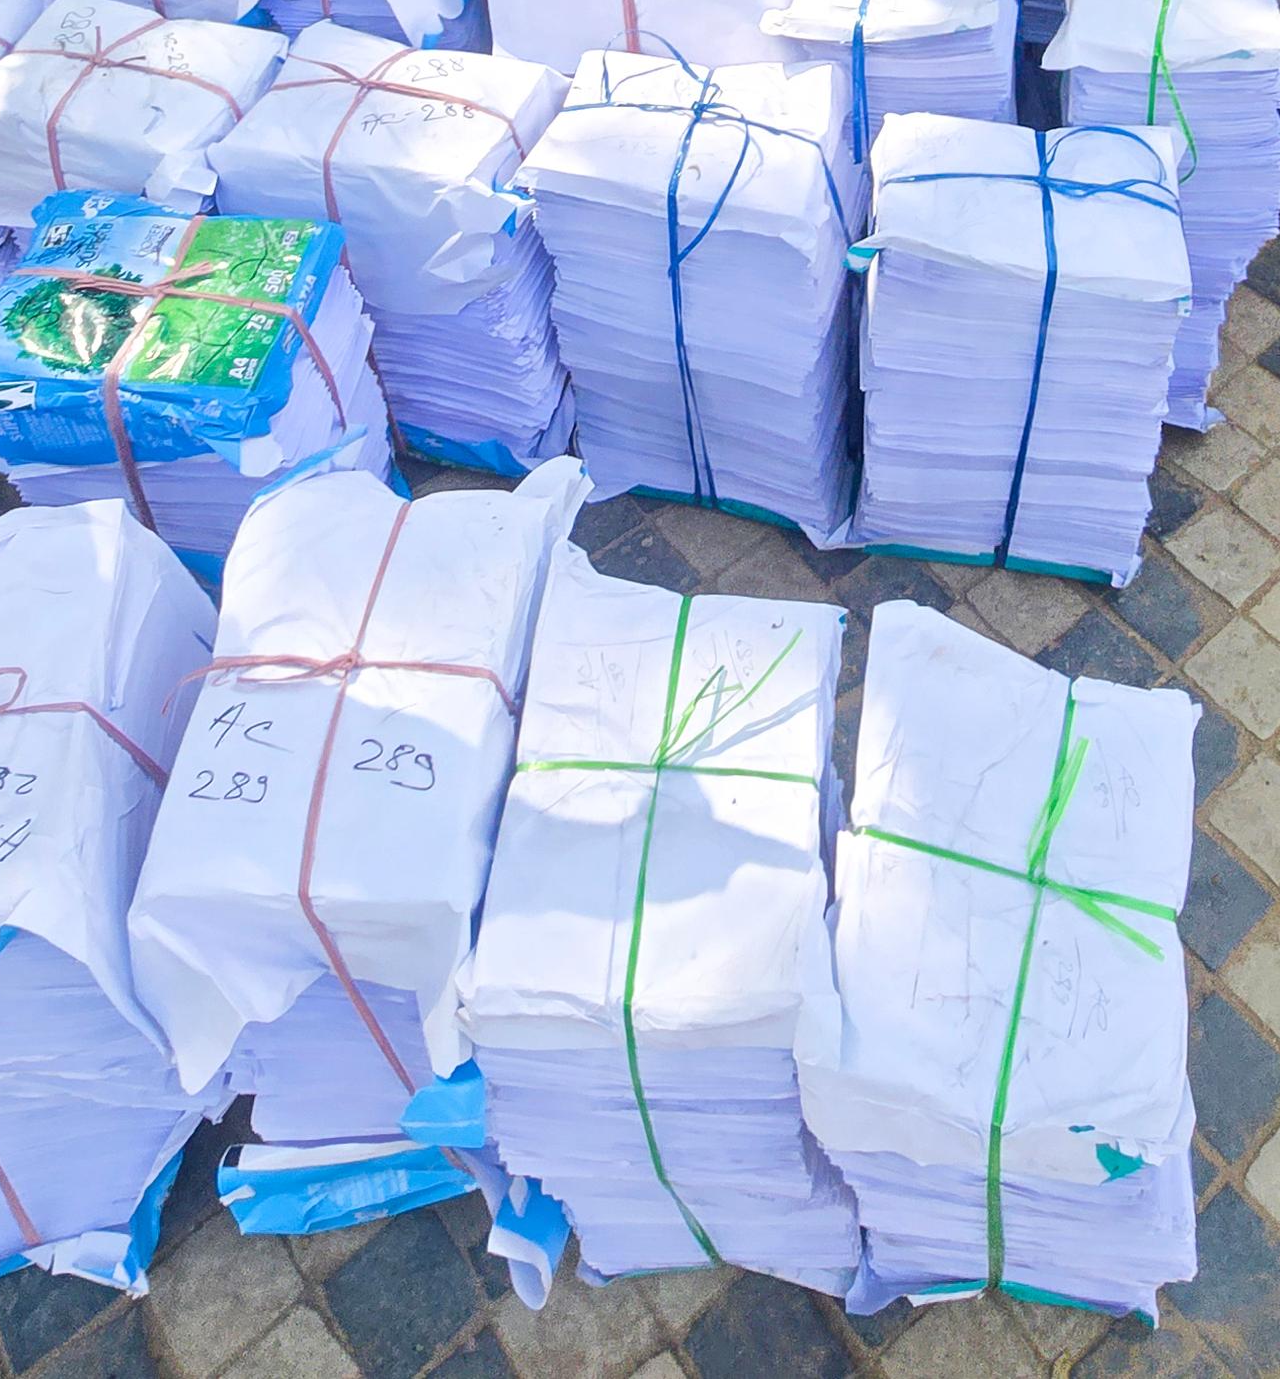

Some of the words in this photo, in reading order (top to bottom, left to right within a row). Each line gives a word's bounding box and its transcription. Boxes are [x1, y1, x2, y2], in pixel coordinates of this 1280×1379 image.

[246, 313, 267, 331] 75
[228, 357, 249, 380] A4
[209, 701, 294, 749] AC
[353, 738, 436, 791] 289
[188, 769, 269, 804] 289
